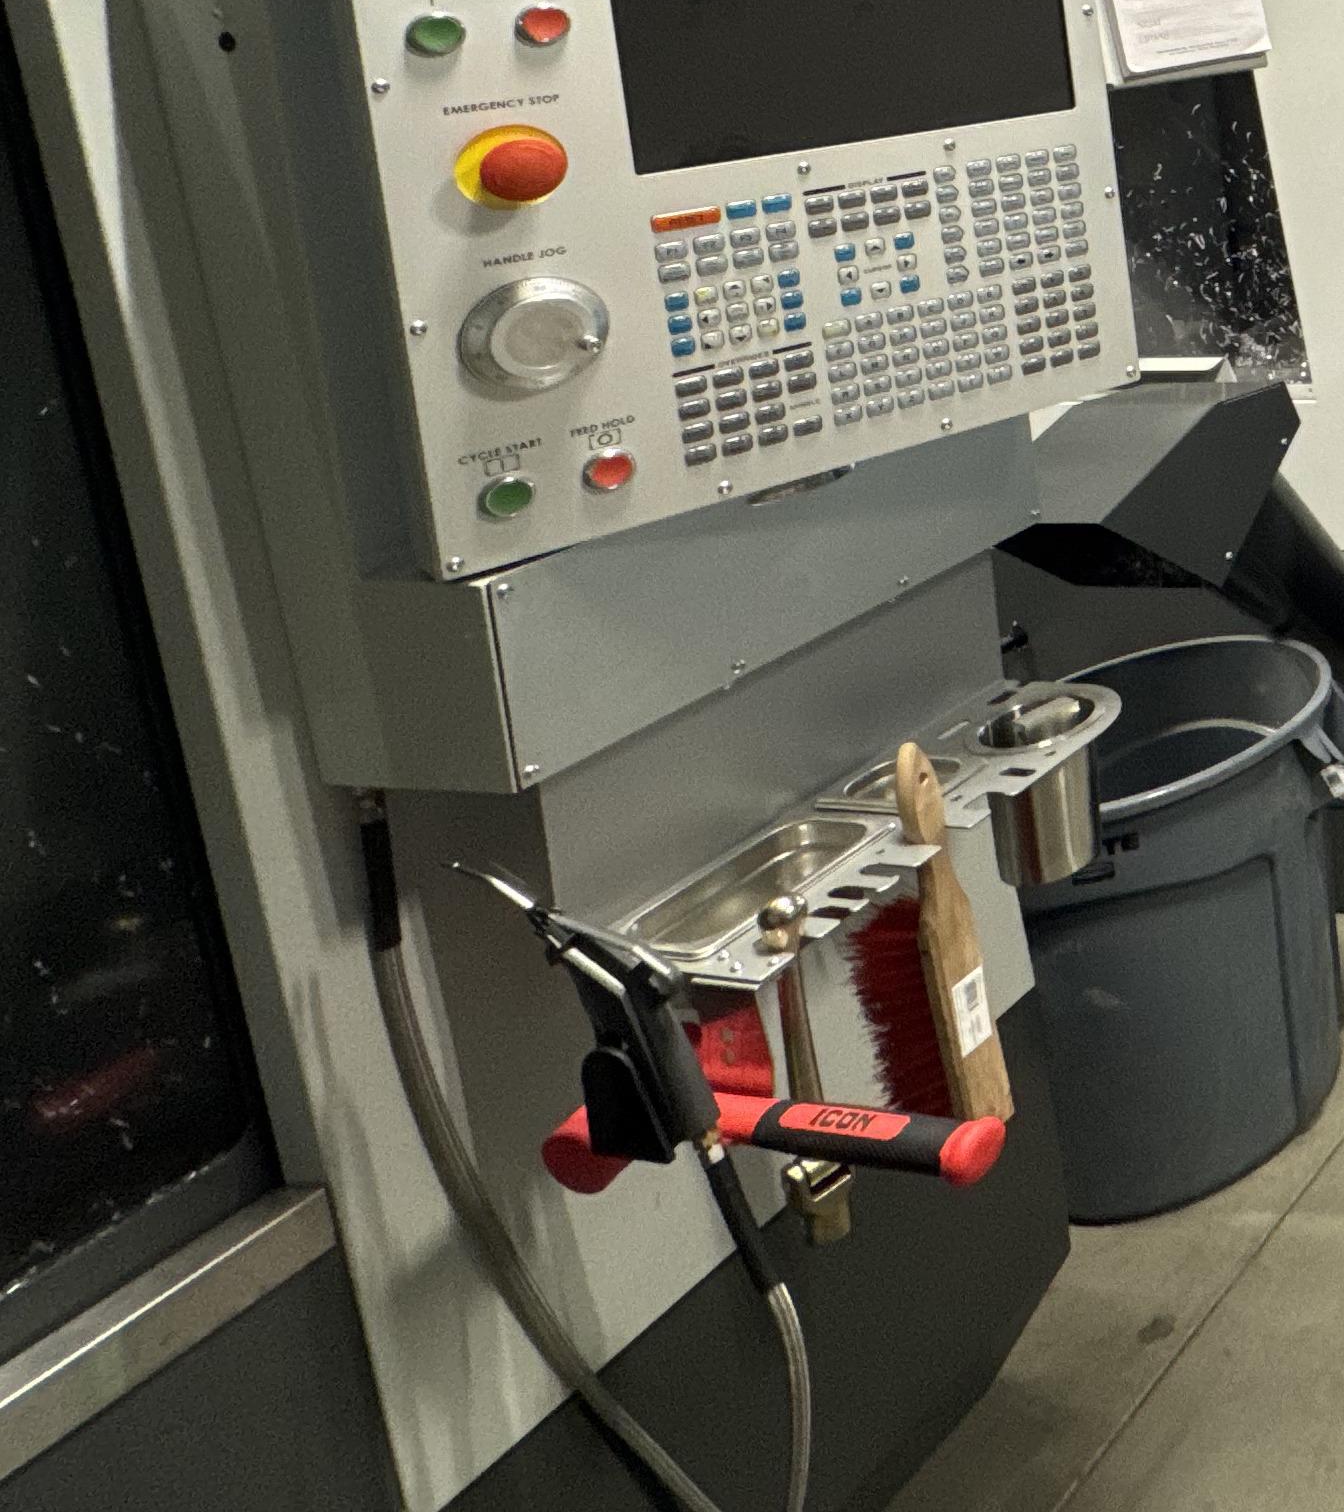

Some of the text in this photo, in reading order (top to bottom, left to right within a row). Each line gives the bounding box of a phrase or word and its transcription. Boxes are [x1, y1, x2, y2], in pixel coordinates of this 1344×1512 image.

[442, 94, 560, 116] EMERGENCY STOP
[482, 245, 568, 268] HANDLE JOG
[569, 414, 636, 438] FEED HOLD
[457, 437, 543, 466] CYCLE START
[808, 1108, 877, 1132] ICON
